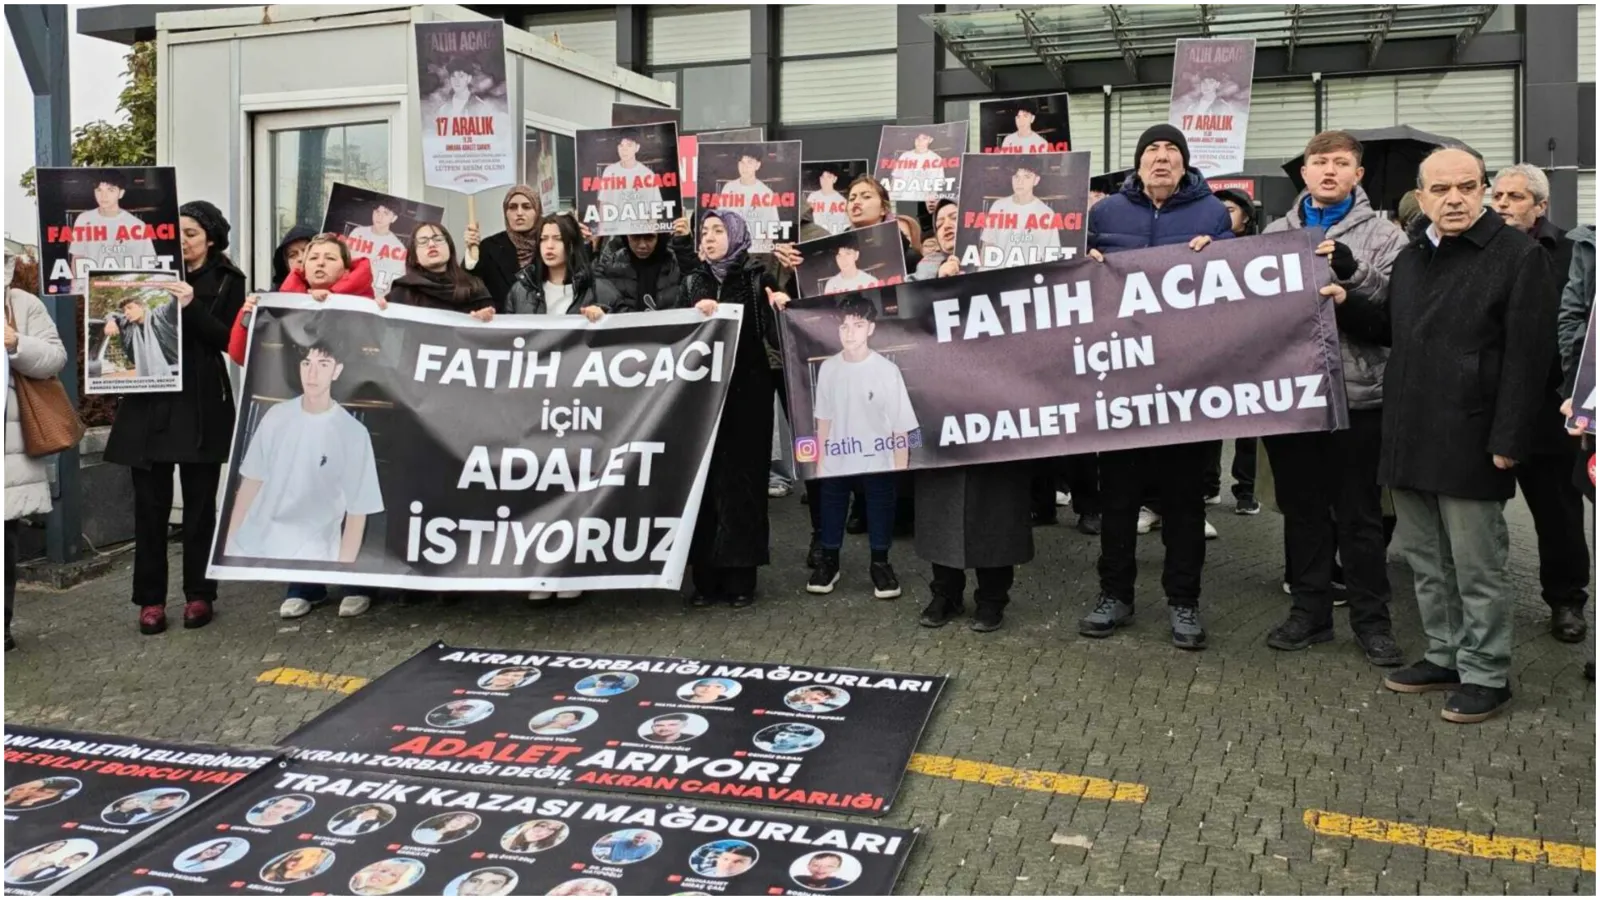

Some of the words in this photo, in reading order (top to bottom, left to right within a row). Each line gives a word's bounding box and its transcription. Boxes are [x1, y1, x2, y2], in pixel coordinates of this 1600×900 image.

[435, 116, 449, 136] 17
[452, 115, 495, 136] ARALIK
[1182, 115, 1194, 131] 17
[1195, 115, 1234, 131] ARALIK
[880, 156, 919, 169] FATİH
[922, 156, 960, 169] ACACI
[582, 173, 627, 191] FATİH
[633, 172, 677, 190] ACACI
[880, 176, 956, 193] ADALET
[583, 200, 677, 223] ADALET
[701, 191, 745, 208] FATİH
[751, 191, 795, 208] ACACI
[47, 221, 108, 243] FATİH
[115, 223, 176, 241] ACACI
[755, 220, 793, 240] LET
[964, 209, 1019, 230] FATİH
[1025, 212, 1083, 231] ACACI
[933, 273, 1095, 343] FATİH
[1117, 253, 1304, 319] ACACI
[413, 336, 561, 389] FATİH
[572, 340, 725, 388] ACACI
[1073, 331, 1156, 380] İÇİN
[541, 398, 603, 438] İÇİN
[939, 402, 1080, 447] ADALET
[1095, 373, 1328, 431] İSTİYORUZ
[456, 441, 666, 492] ADALET
[406, 500, 683, 565] İSTİYORUZ
[439, 650, 549, 667] AKRAN
[547, 655, 710, 677] ZORBALIĞI
[711, 665, 934, 692] MAĞDURLARI
[28, 737, 147, 759] ADALETİN
[143, 749, 275, 770] ELLERİNDE
[30, 752, 107, 772] EVLAT
[97, 761, 190, 780] BORCU
[390, 735, 584, 765] ADALET
[575, 748, 803, 784] ARIYOR!
[364, 754, 500, 776] ZORBALIĞI
[575, 770, 681, 791] AKRAN
[680, 777, 884, 810] CANAVARLIĞI
[274, 772, 424, 803] TRAFİK
[416, 788, 584, 818] KAZASI
[581, 802, 903, 856] MAĞDURLARI
